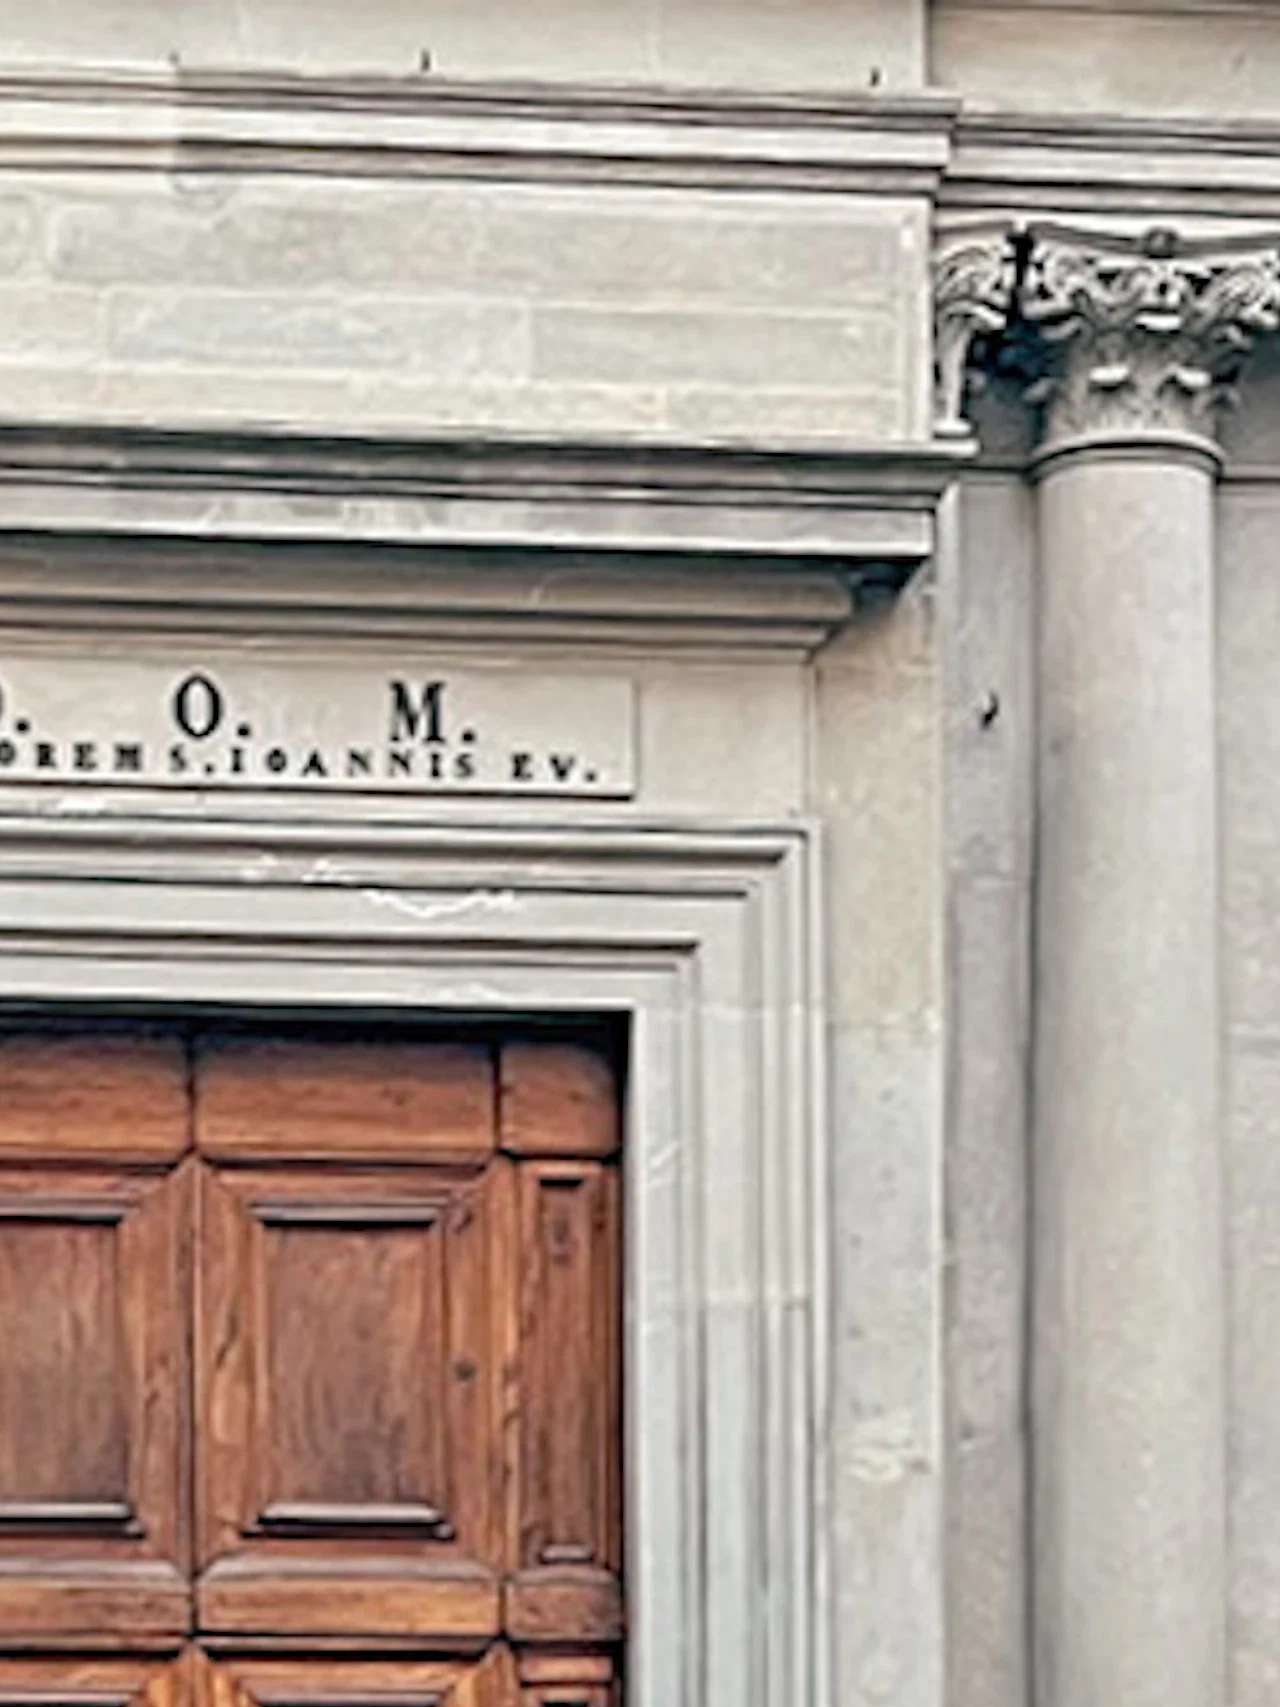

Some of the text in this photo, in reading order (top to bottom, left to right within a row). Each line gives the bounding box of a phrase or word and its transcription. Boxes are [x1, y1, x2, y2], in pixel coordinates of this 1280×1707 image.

[172, 672, 252, 742] O.
[389, 680, 477, 745] M.
[511, 752, 597, 782] EV.
